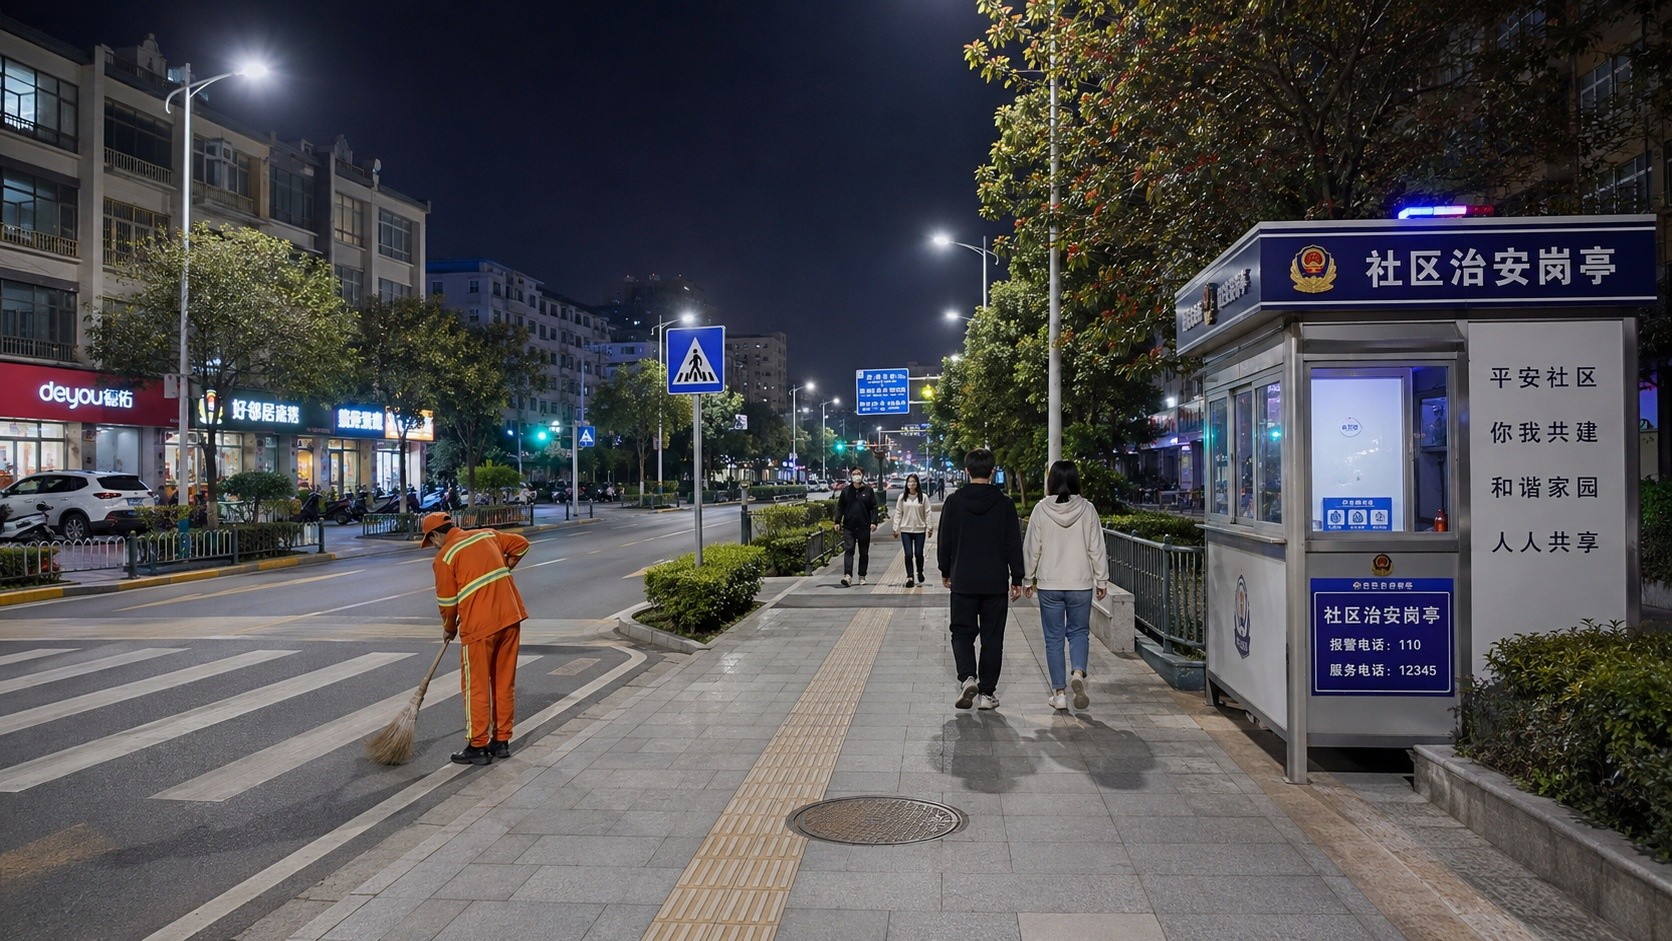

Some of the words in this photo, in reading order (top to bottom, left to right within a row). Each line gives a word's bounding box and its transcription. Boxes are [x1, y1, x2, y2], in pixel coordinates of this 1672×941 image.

[1366, 246, 1616, 288] 社区治安岗亭
[1490, 366, 1597, 389] 平安社区
[1490, 421, 1598, 443] 你我共建
[1491, 476, 1598, 498] 和谐家园
[1492, 531, 1599, 553] 人人共享
[1324, 606, 1440, 624] 社区治安岗亭
